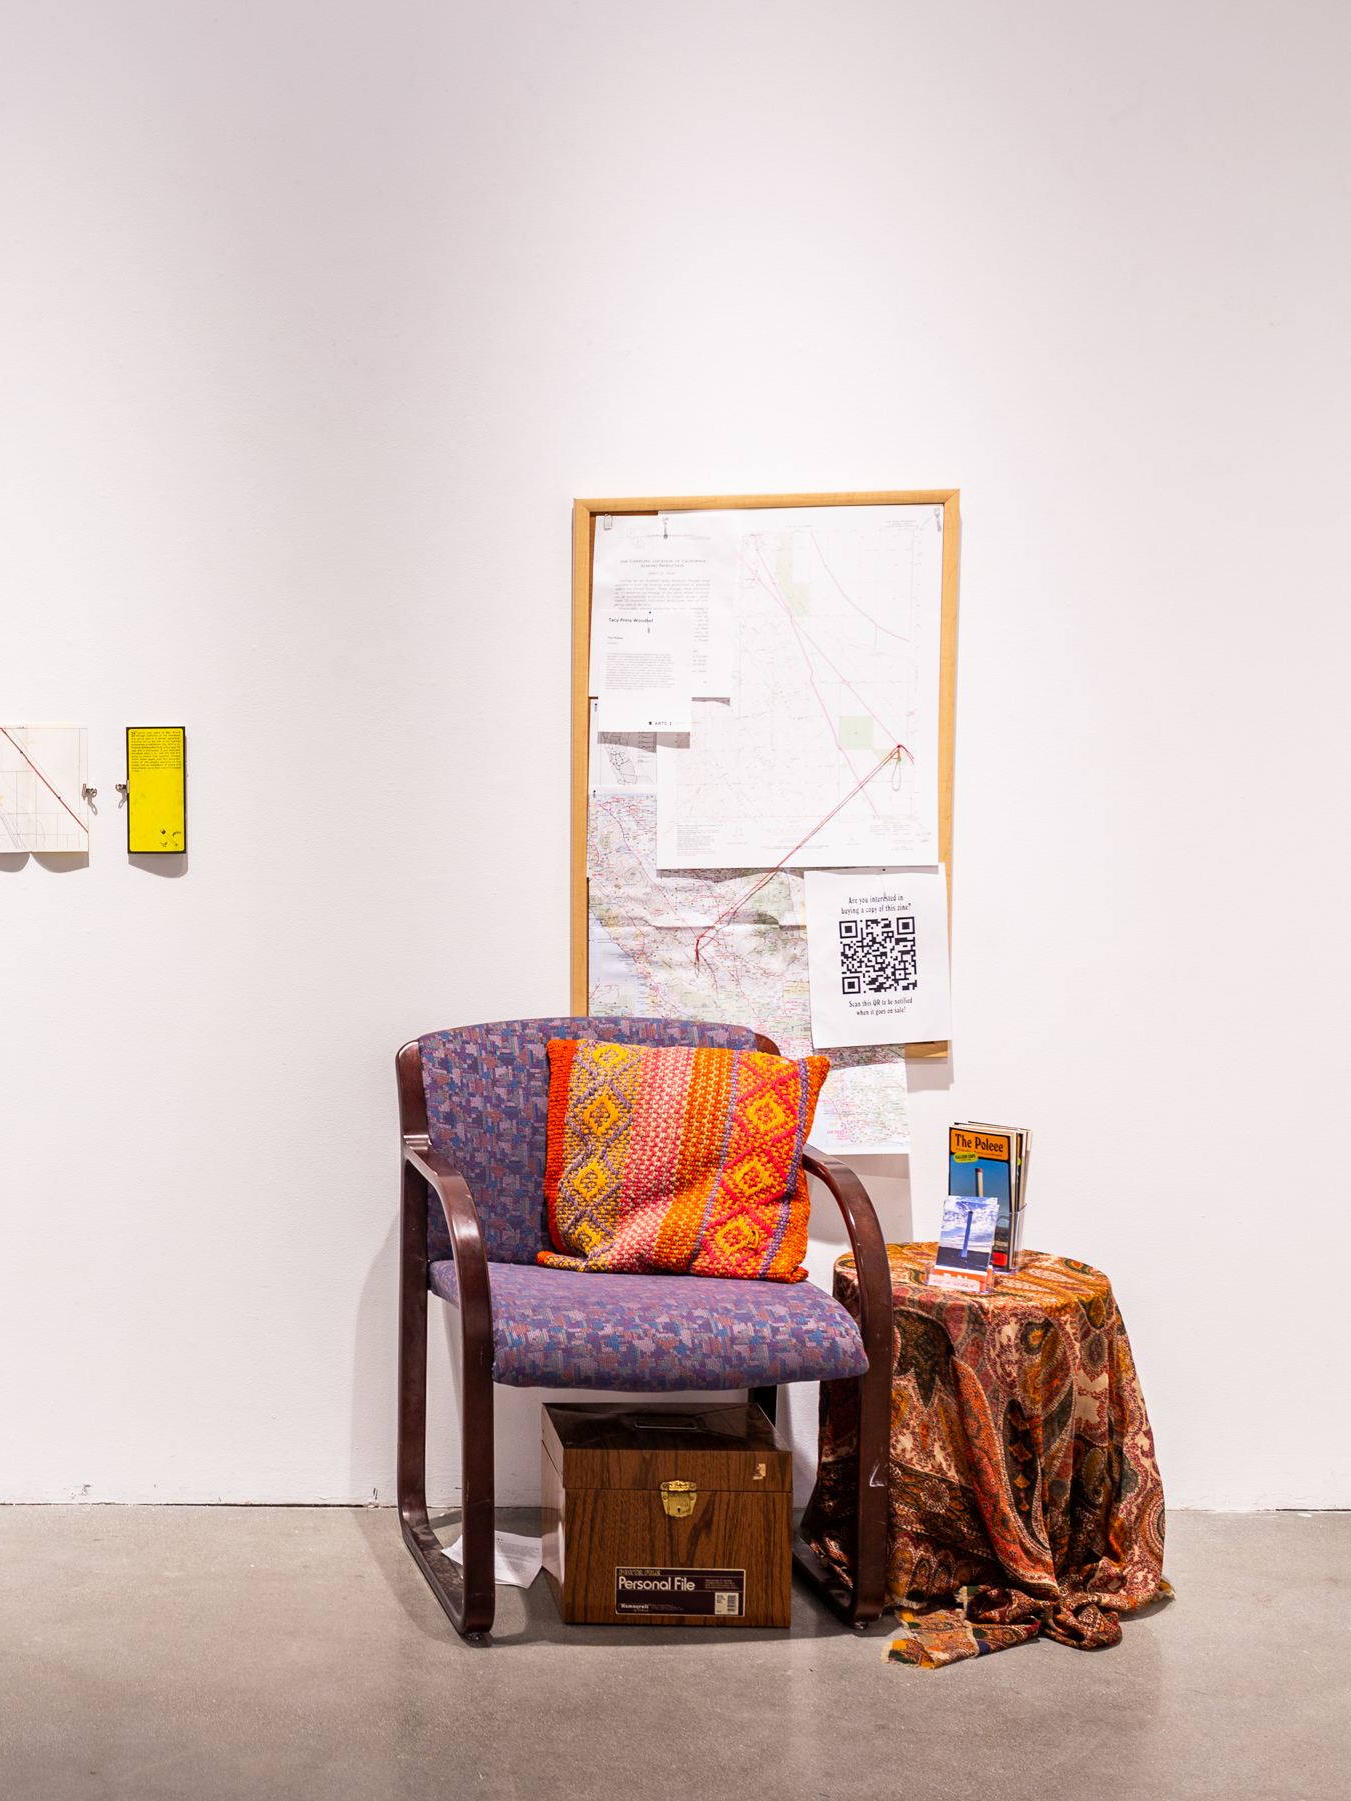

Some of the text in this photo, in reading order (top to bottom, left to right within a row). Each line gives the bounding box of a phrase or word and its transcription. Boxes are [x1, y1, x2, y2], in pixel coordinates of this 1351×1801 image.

[870, 894, 896, 903] interested
[841, 907, 859, 915] buying
[897, 903, 911, 911] zine?
[955, 1133, 1003, 1152] The Poleee
[618, 1576, 671, 1590] Personal
[674, 1578, 695, 1591] File
